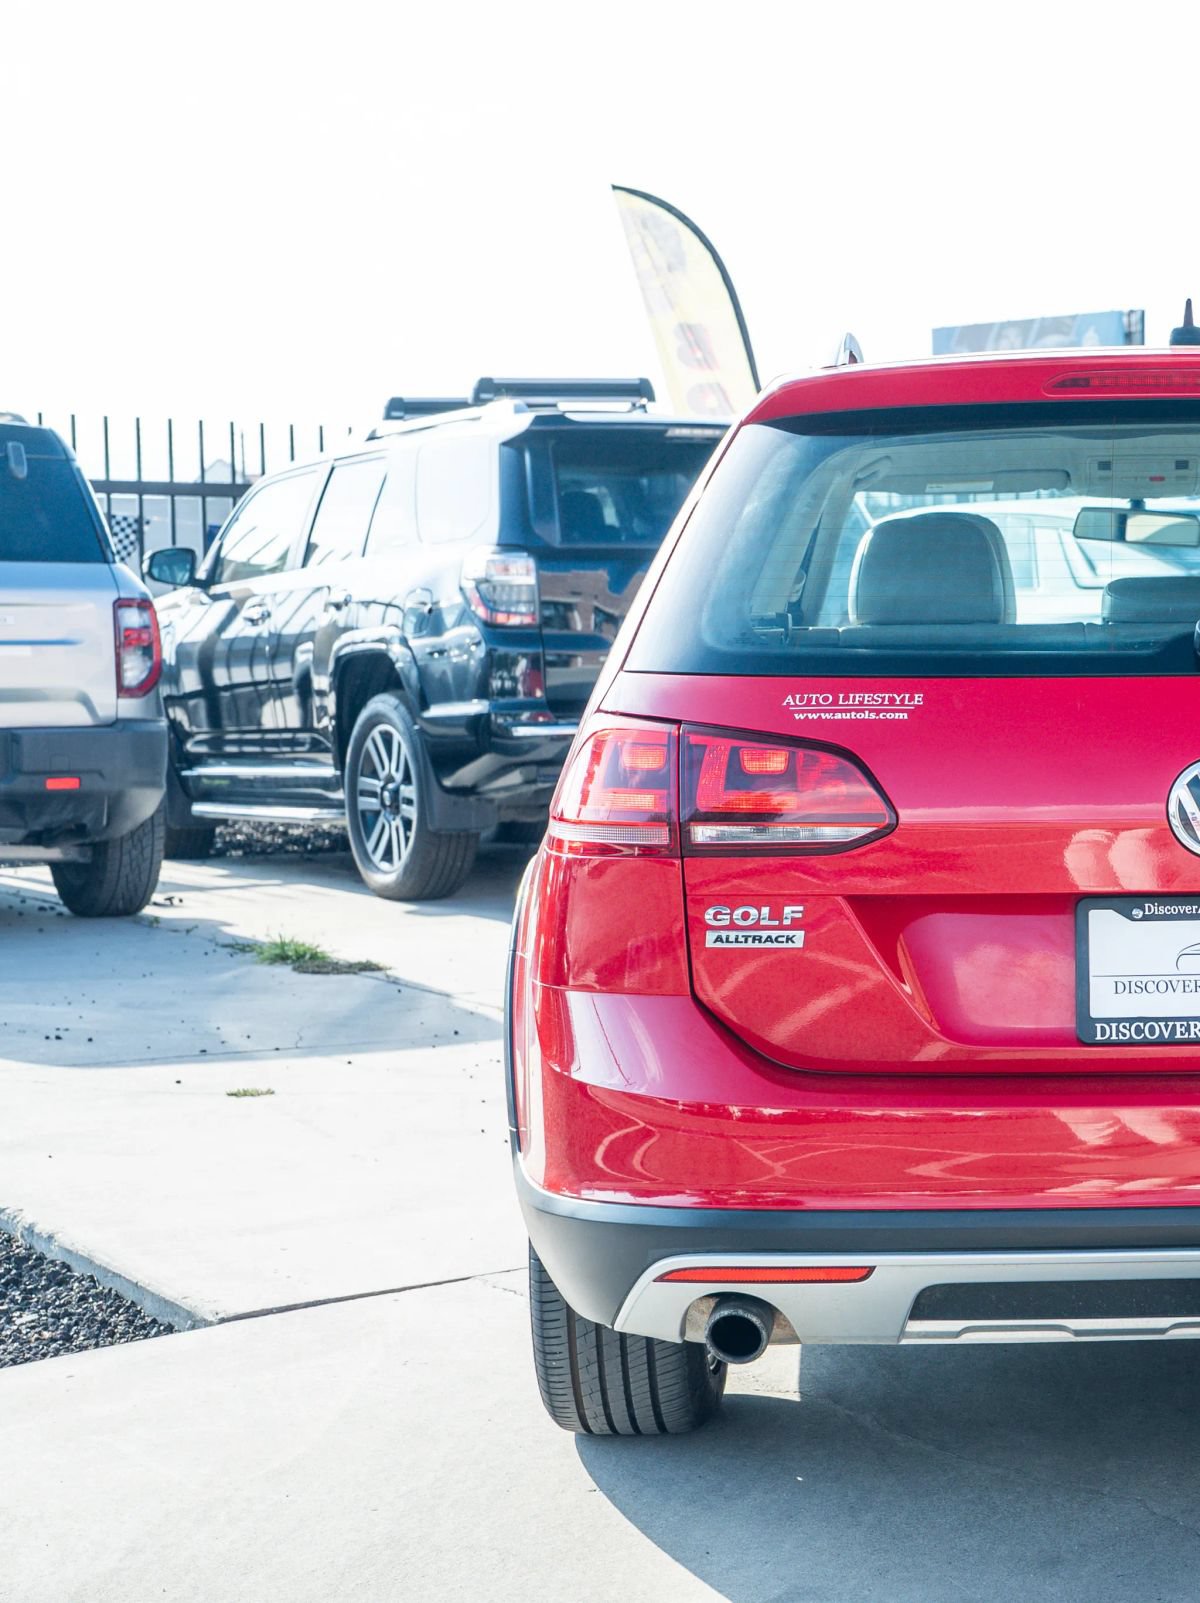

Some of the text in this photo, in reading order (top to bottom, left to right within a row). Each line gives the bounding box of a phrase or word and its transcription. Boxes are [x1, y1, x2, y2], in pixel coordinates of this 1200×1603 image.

[782, 693, 924, 706] AUTO LIFESTYLE
[793, 710, 909, 720] www.autols.com
[704, 905, 804, 926] GOLF
[713, 934, 797, 944] ALLTRACK
